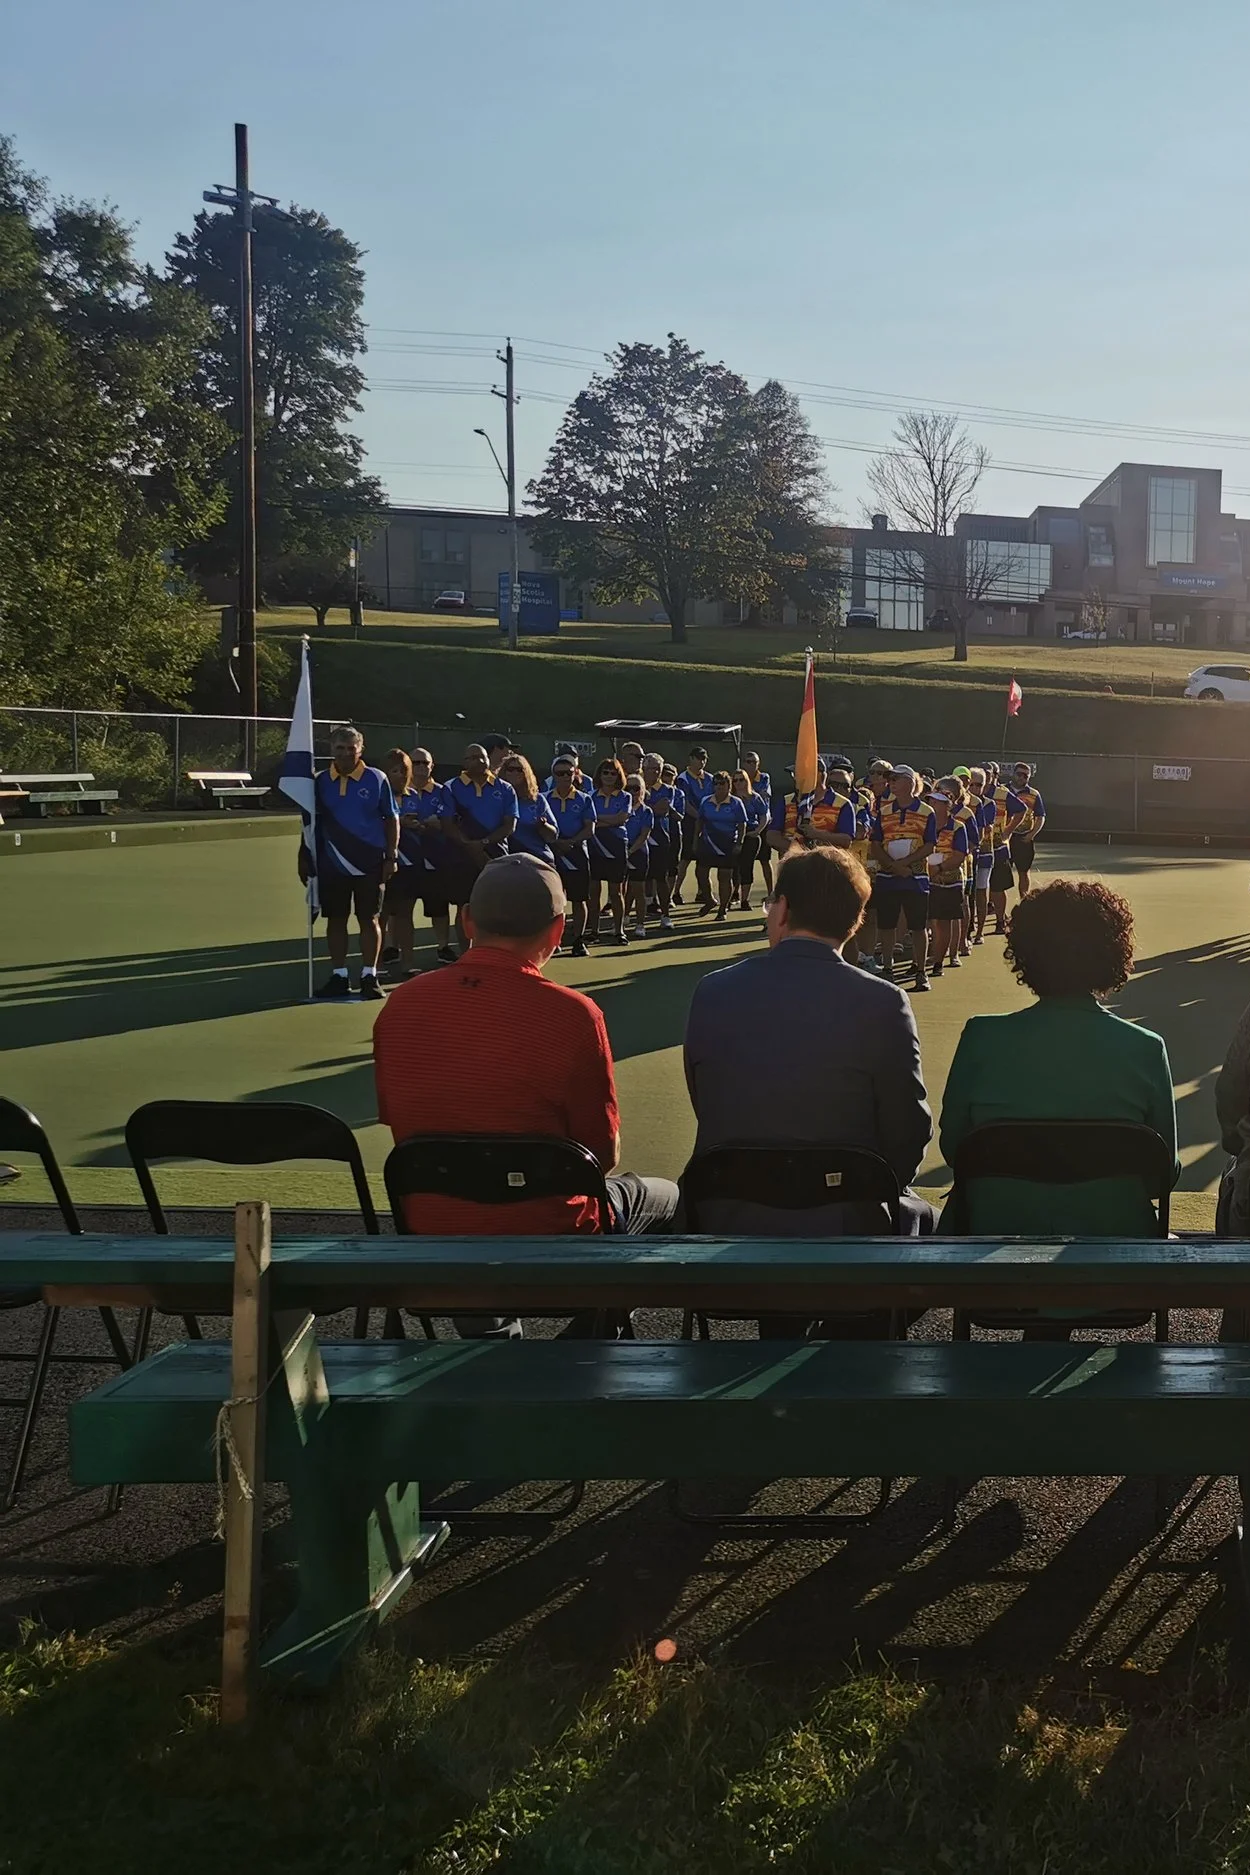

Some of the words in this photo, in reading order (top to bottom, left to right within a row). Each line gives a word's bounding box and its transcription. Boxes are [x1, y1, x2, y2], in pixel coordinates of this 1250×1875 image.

[1172, 576, 1195, 585] Mount
[1197, 579, 1216, 588] Hope
[521, 588, 545, 597] Scotia
[521, 596, 553, 605] Hospital
